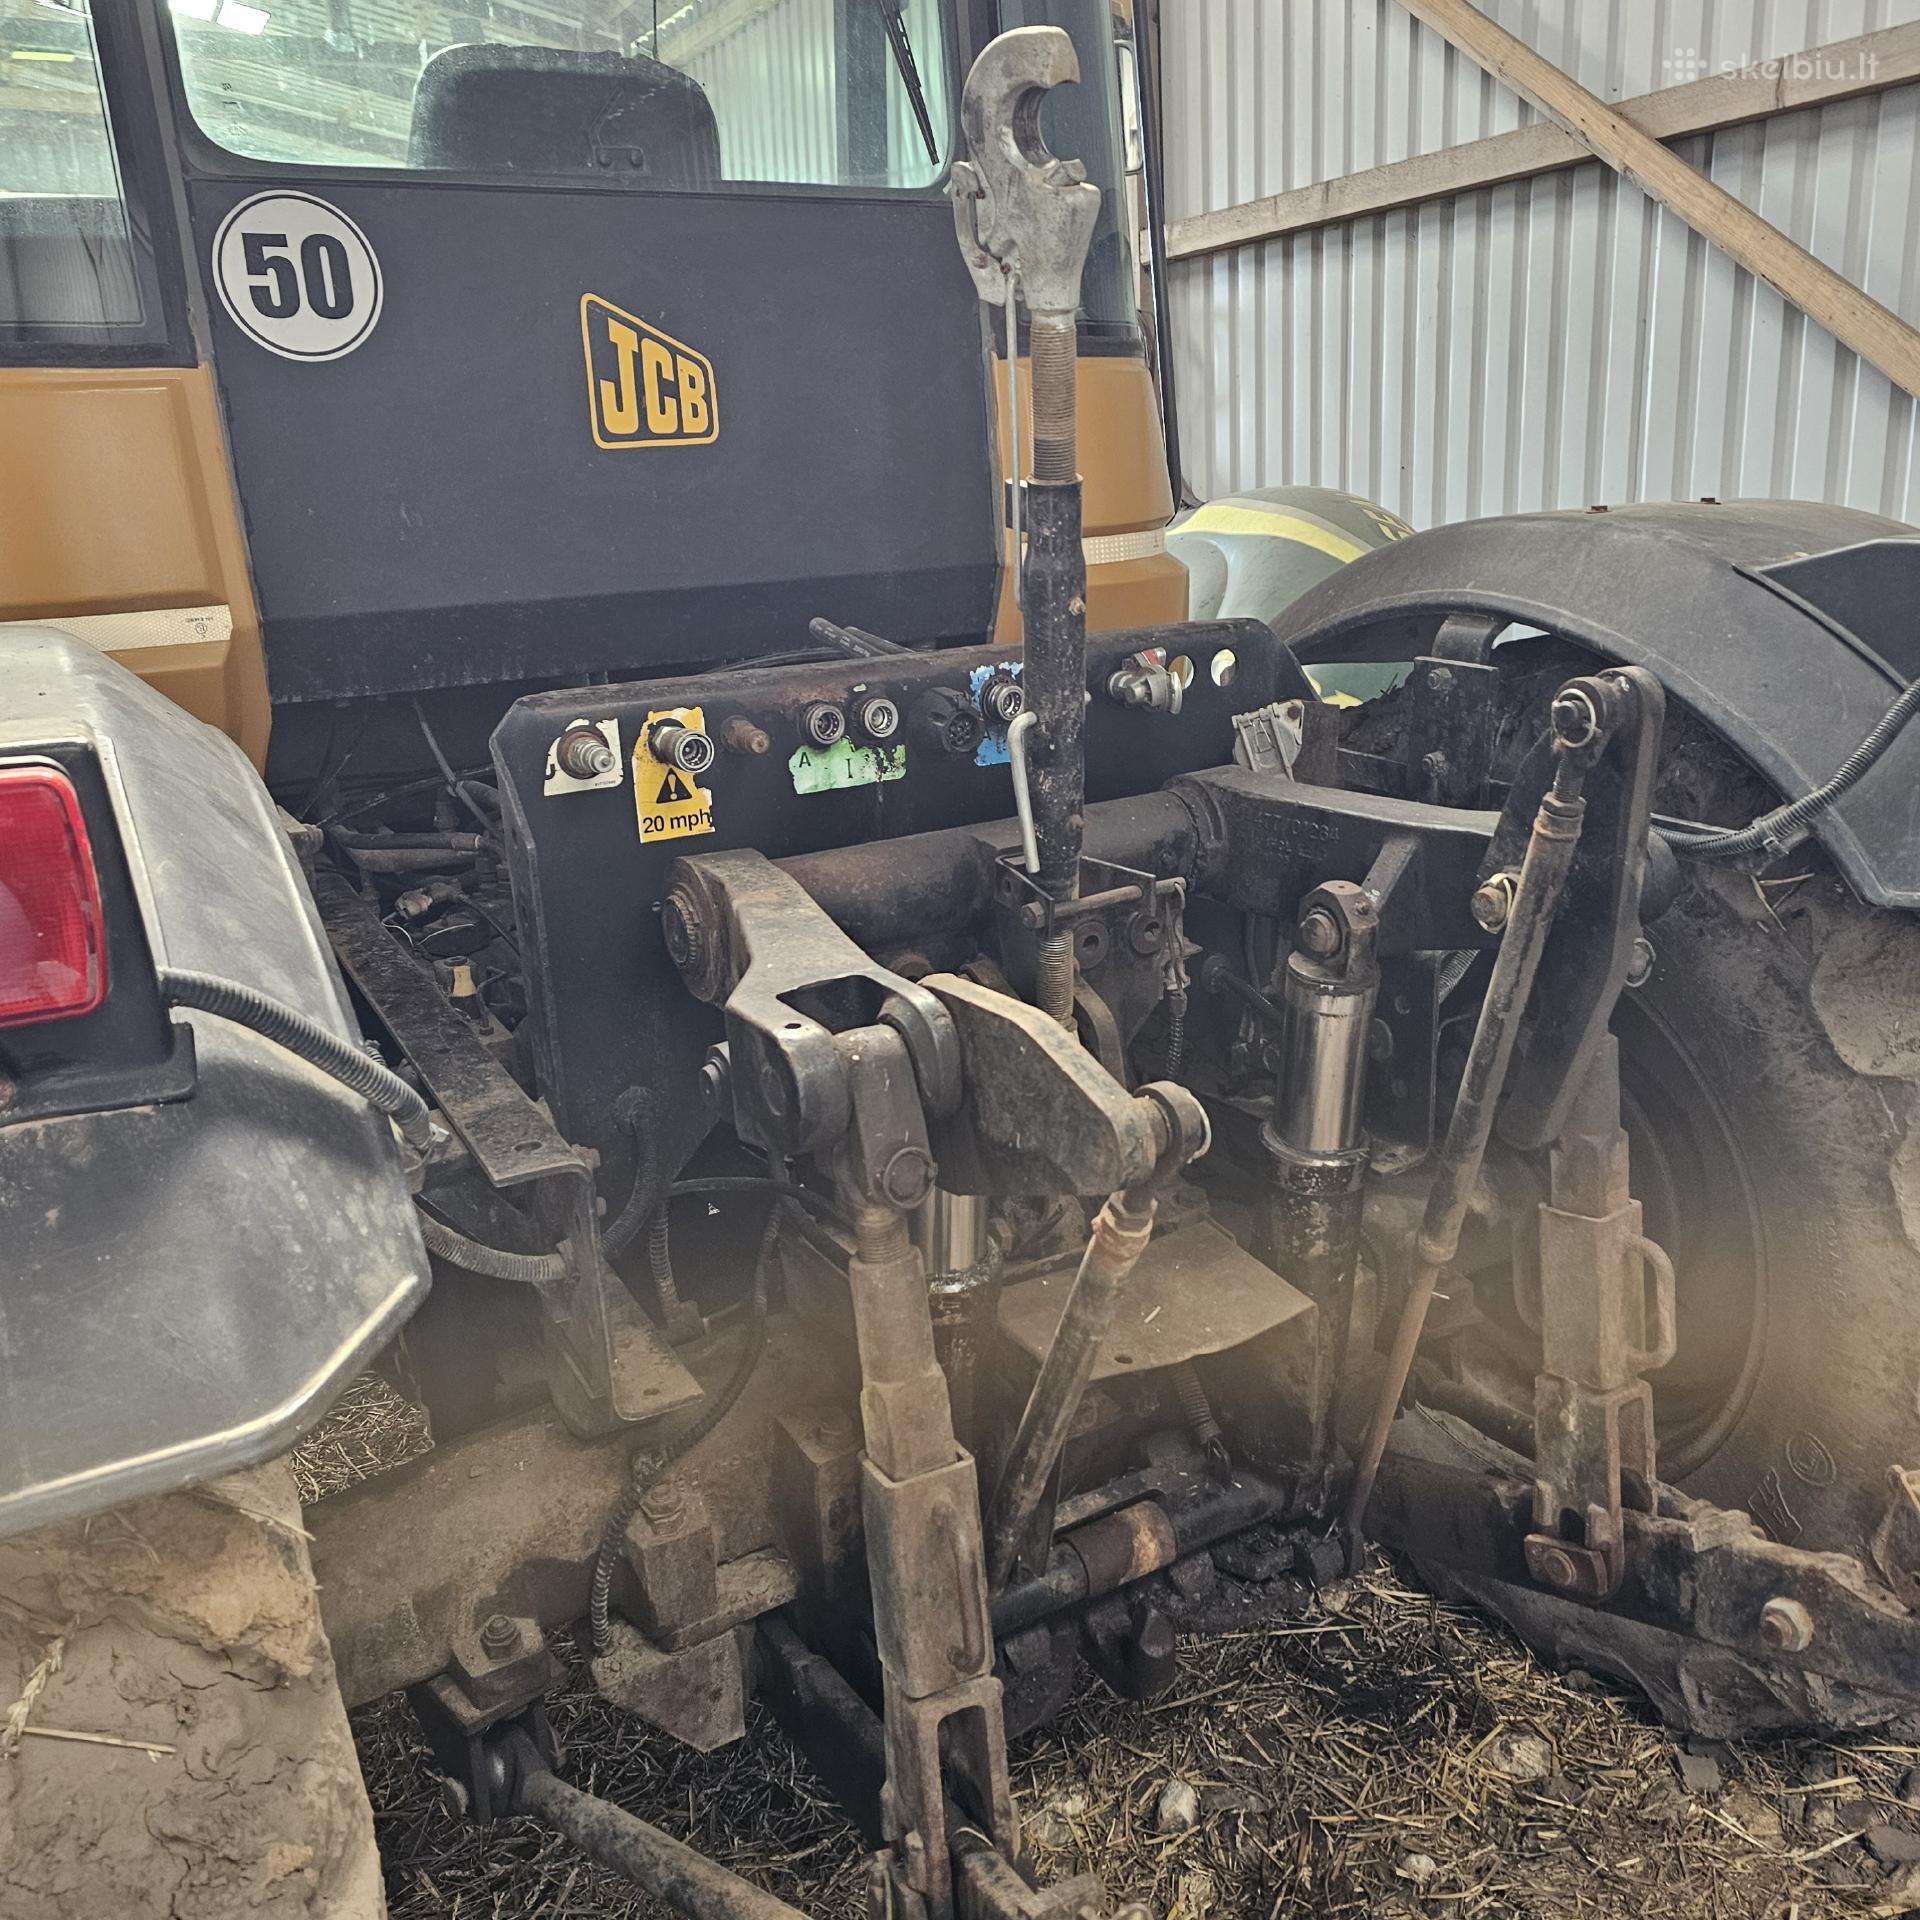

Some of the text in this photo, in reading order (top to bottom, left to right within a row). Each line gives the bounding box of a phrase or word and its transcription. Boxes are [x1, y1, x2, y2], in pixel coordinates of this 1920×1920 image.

[242, 233, 354, 319] 50
[600, 317, 708, 434] JCB
[643, 809, 711, 833] 20 mph
